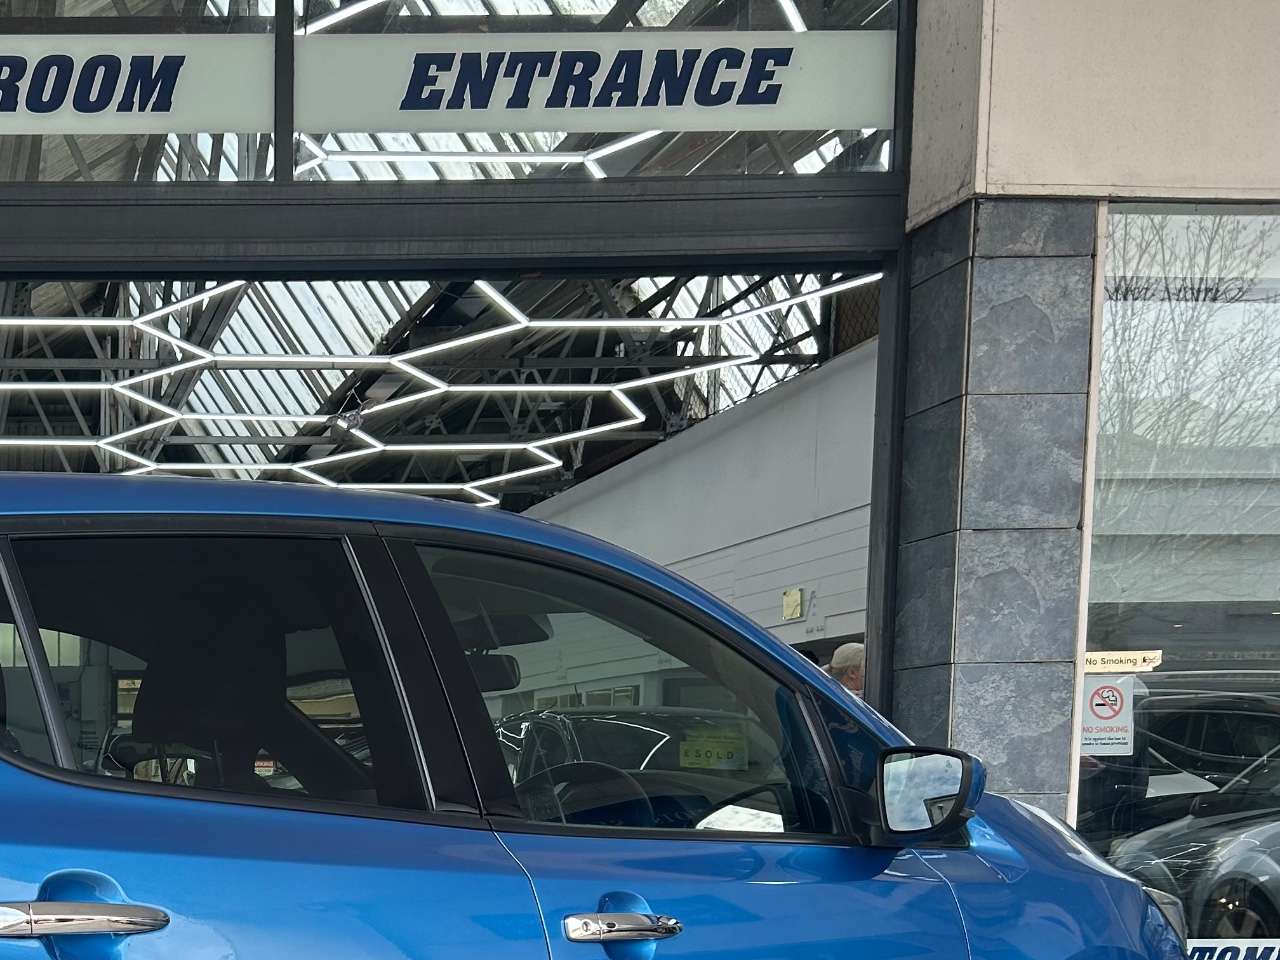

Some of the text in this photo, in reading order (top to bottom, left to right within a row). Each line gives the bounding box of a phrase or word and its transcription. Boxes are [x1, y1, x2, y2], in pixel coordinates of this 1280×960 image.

[399, 47, 794, 111] ENTRANCE
[1085, 657, 1138, 667] No Smoking
[694, 749, 734, 760] SOLD
